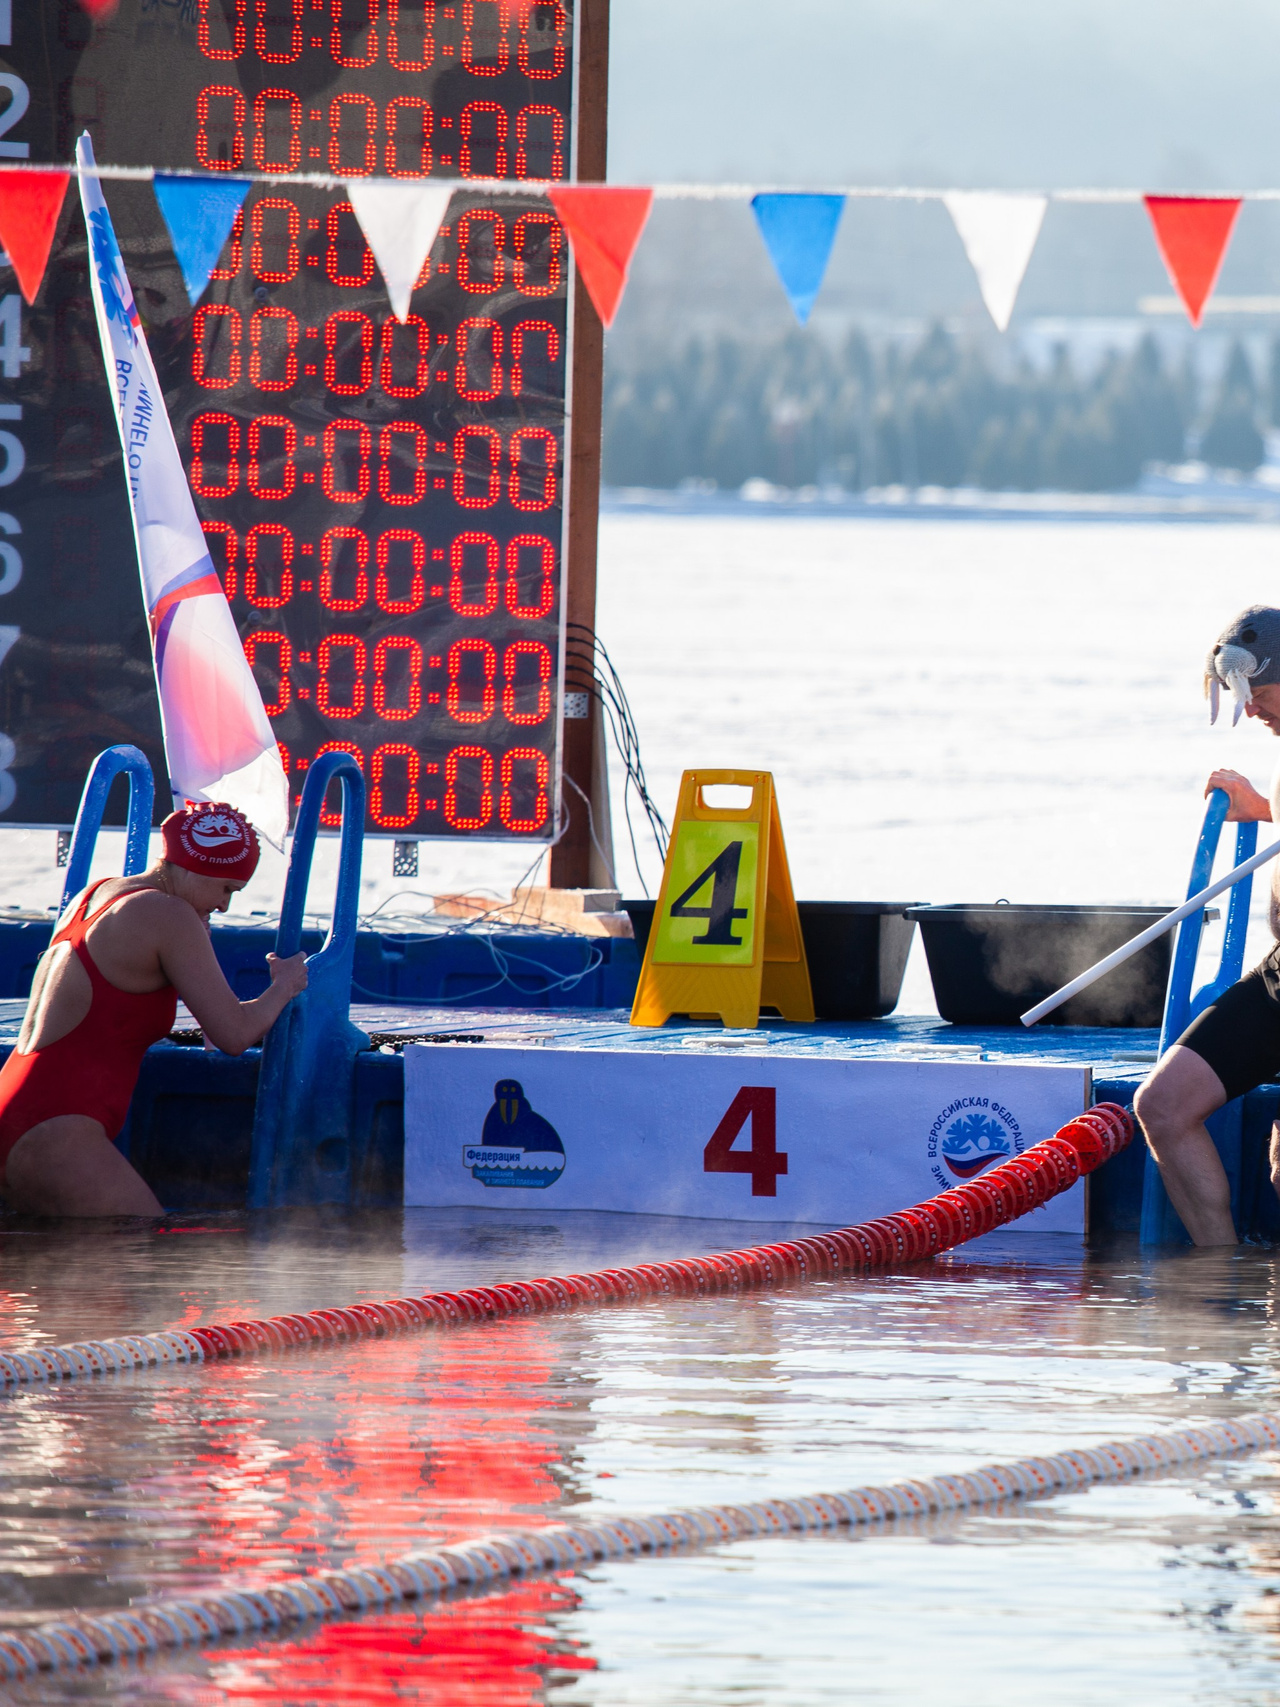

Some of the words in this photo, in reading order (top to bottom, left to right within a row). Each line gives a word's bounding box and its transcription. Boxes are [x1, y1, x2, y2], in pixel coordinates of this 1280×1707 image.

[196, 85, 563, 184] 00:00:00
[191, 413, 557, 511] 00:00:00
[180, 834, 207, 861] ЗИМНЕГО
[209, 847, 249, 864] ПЛАВАНИЯ
[670, 841, 748, 945] 4
[467, 1150, 520, 1163] Федерация
[704, 1086, 788, 1197] 4
[928, 1096, 989, 1158] ВСЕРОССИЙСКАЯ
[991, 1102, 1025, 1156] ФЕДЕРАЦИ
